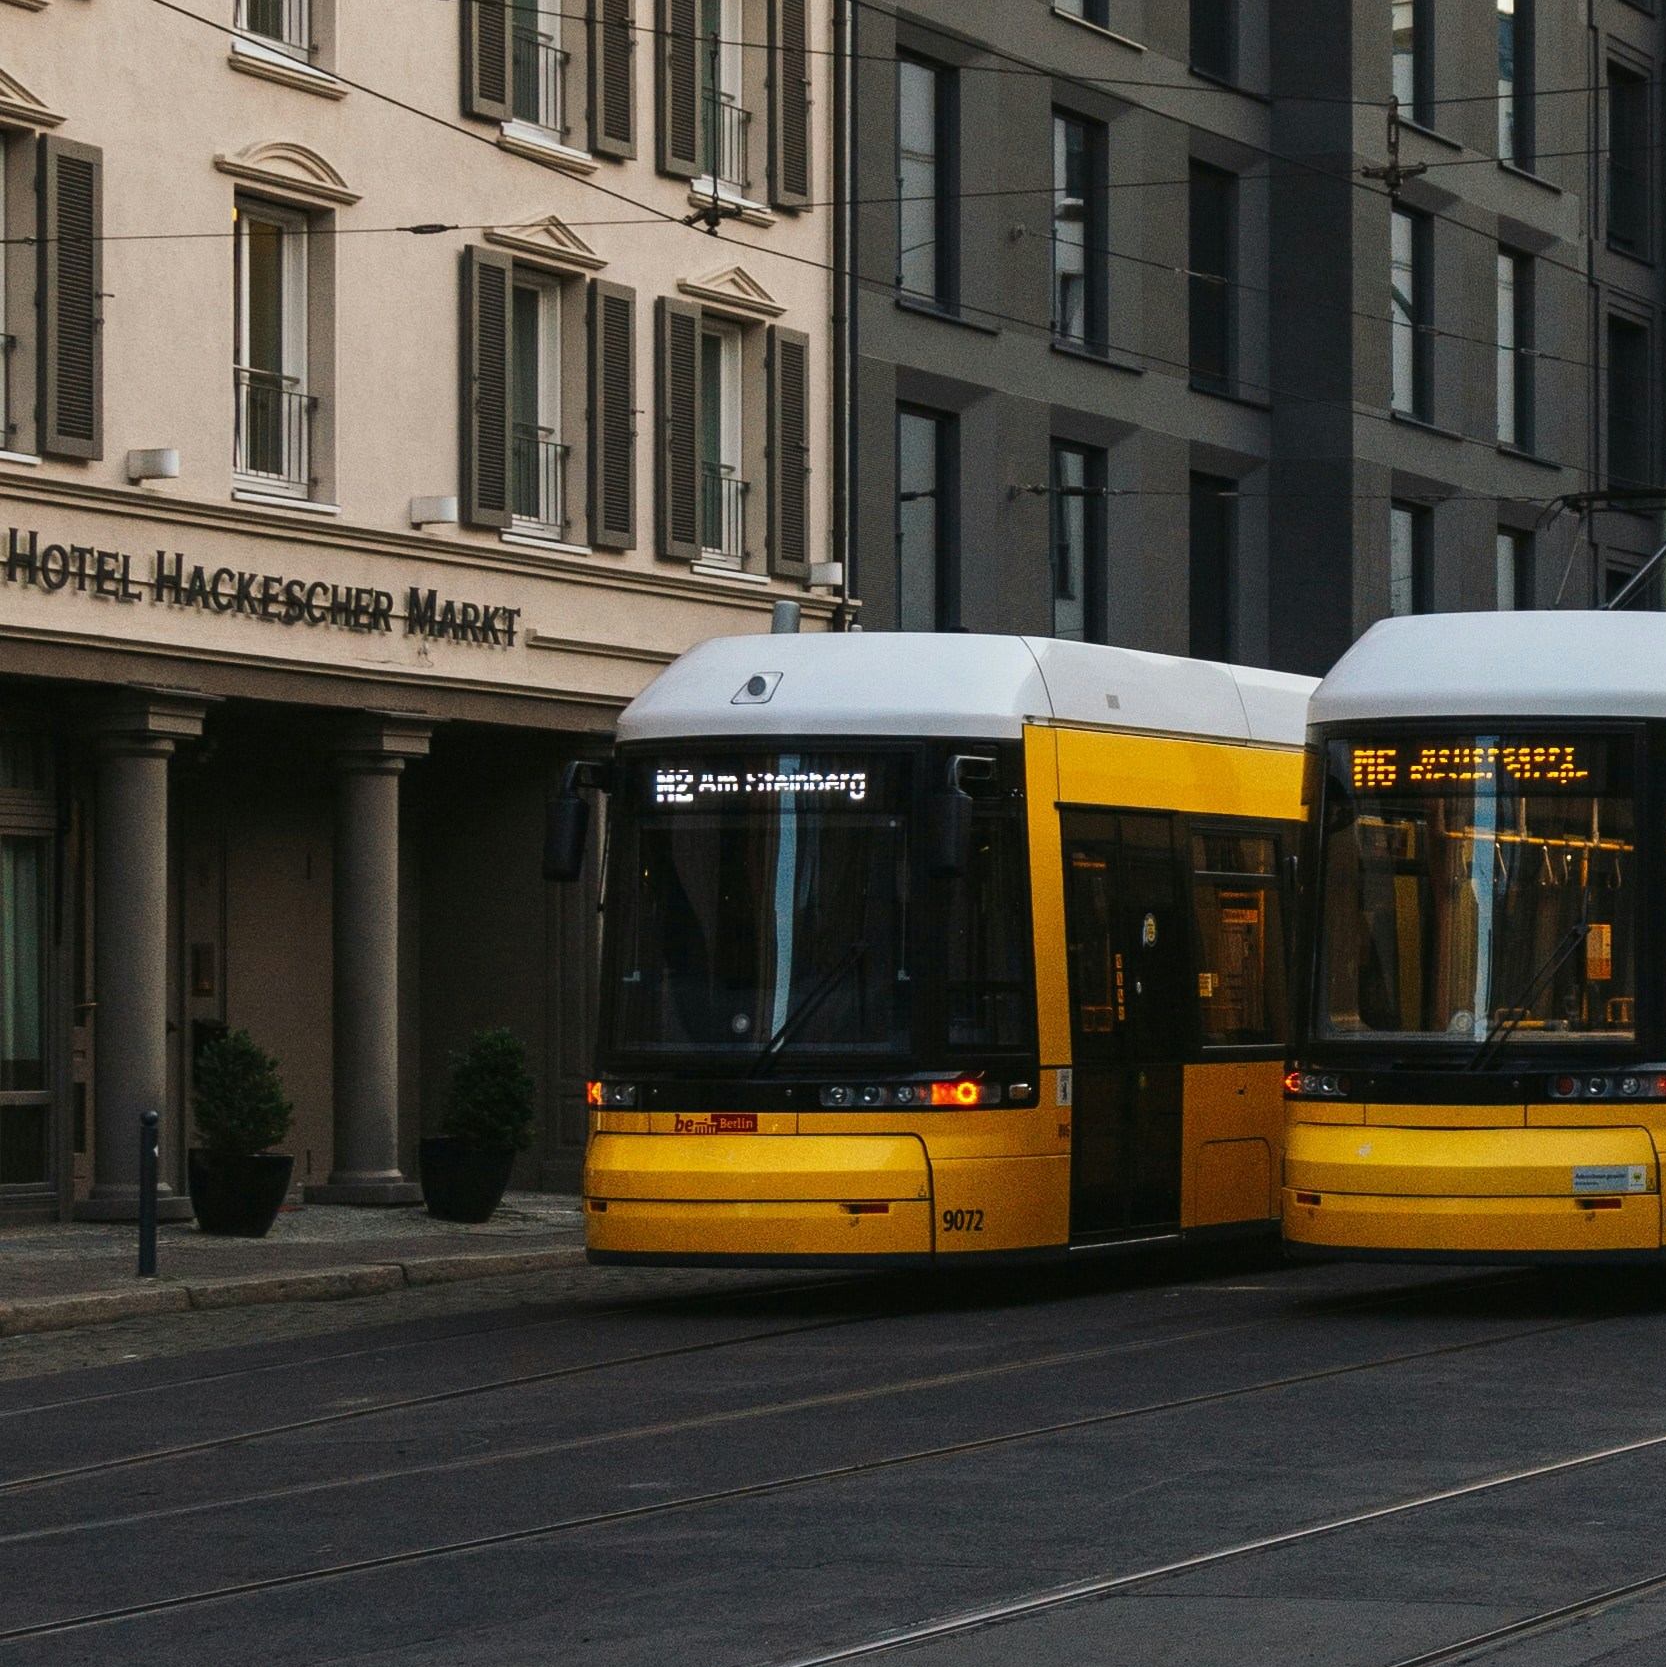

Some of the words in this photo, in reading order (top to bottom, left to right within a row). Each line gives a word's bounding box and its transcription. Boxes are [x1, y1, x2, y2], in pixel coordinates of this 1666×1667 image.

[7, 527, 142, 602] HOTEL
[154, 550, 394, 632] HACKESCHER
[407, 586, 521, 647] MARKT
[699, 774, 738, 791] Am
[719, 1117, 754, 1129] Berlin
[942, 1209, 985, 1232] 9072
